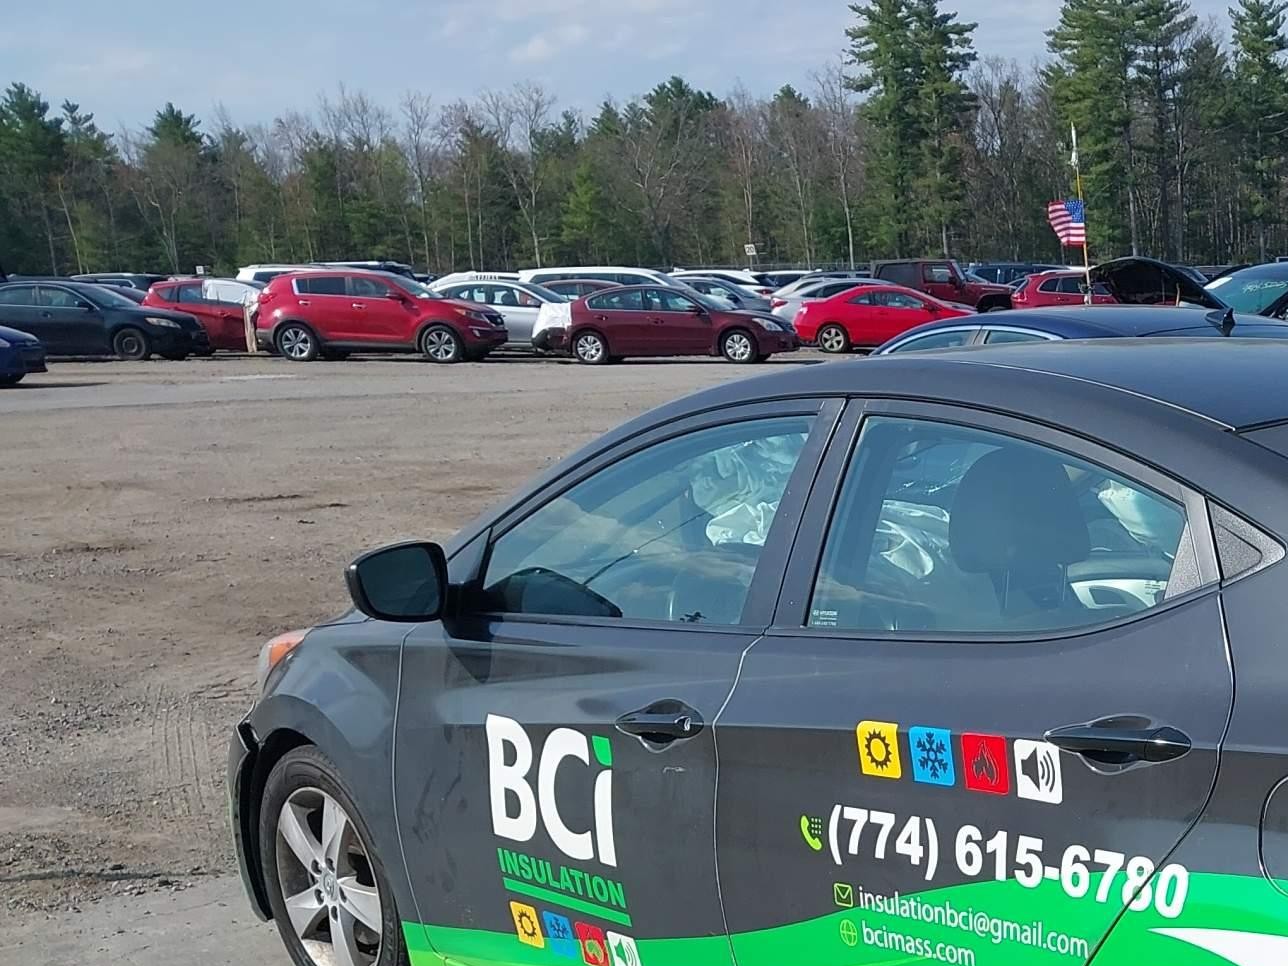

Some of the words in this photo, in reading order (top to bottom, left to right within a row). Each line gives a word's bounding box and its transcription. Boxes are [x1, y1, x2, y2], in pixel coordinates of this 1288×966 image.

[497, 847, 627, 909] INSULATION
[828, 803, 940, 881] (774)
[954, 825, 1190, 919] 615-6780
[858, 885, 1090, 960] insulationbci@gmail.com
